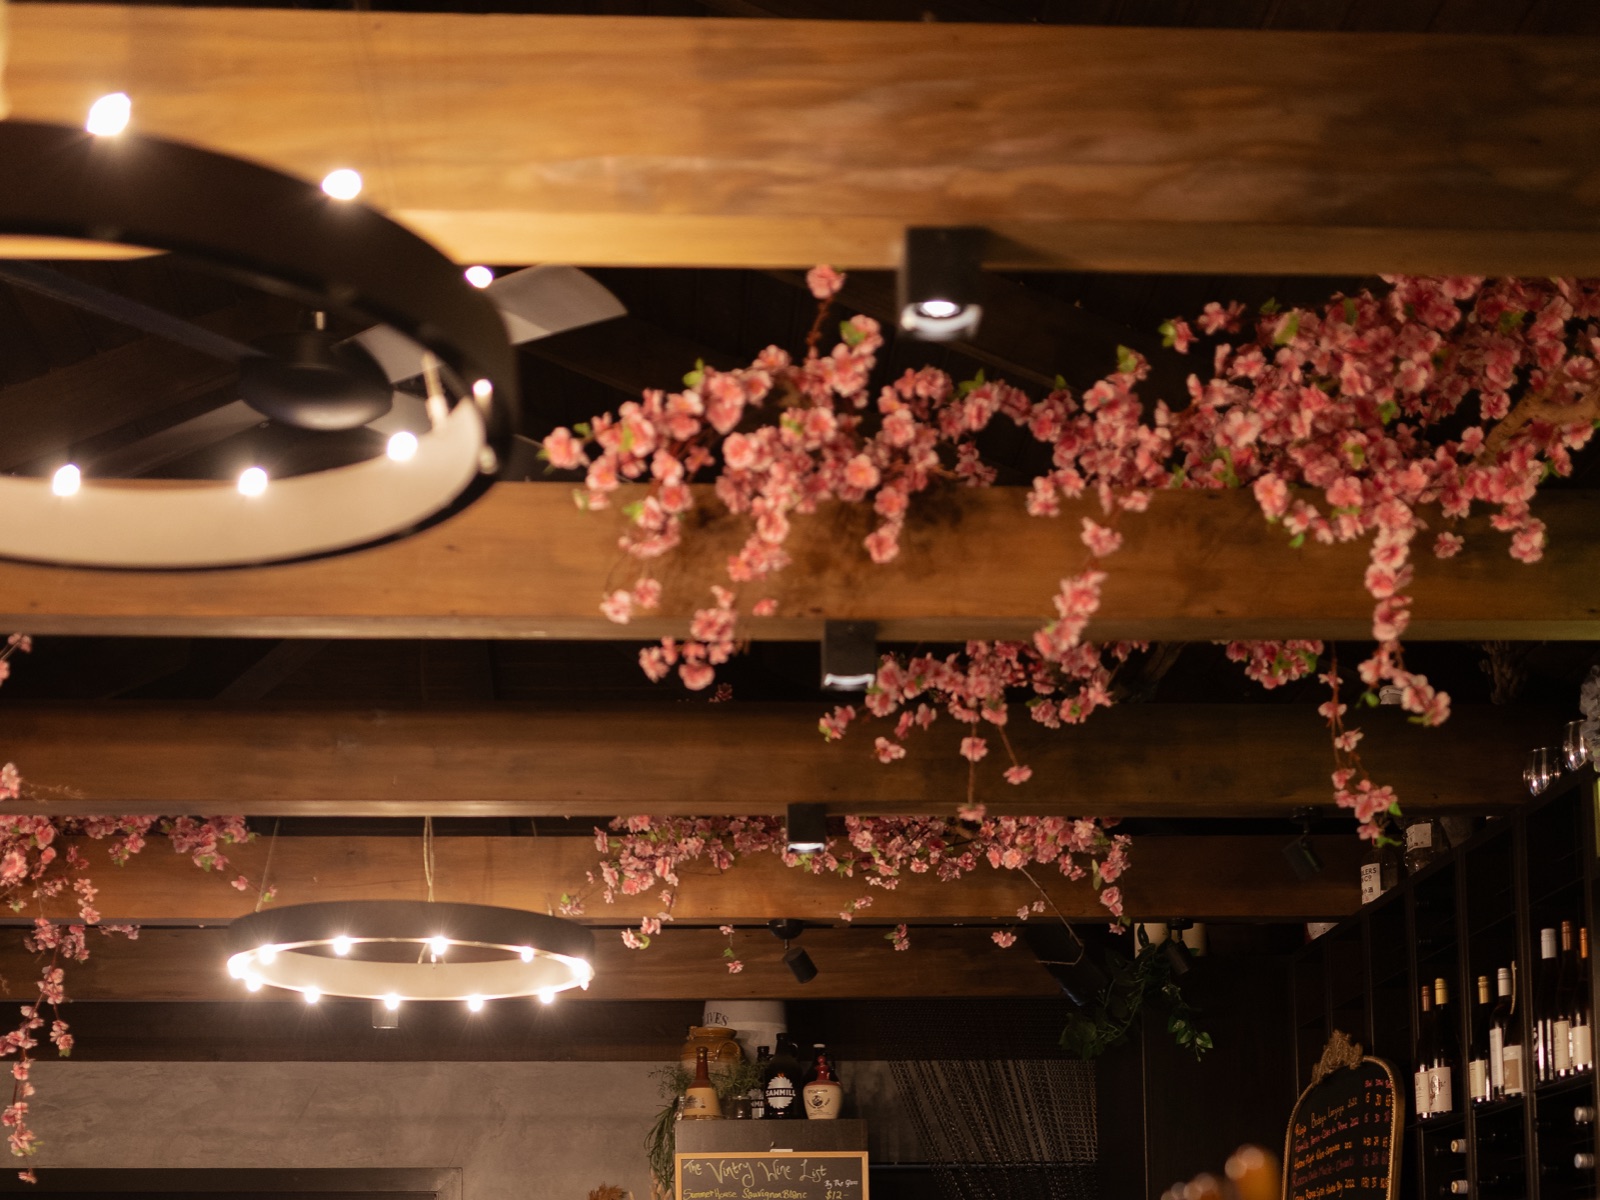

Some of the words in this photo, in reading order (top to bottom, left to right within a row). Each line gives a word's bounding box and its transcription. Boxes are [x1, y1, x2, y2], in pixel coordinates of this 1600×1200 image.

[765, 1089, 796, 1097] SAWMILL
[684, 1160, 702, 1175] The
[706, 1160, 755, 1188] Vintry
[758, 1159, 792, 1181] Wine
[799, 1159, 828, 1182] List
